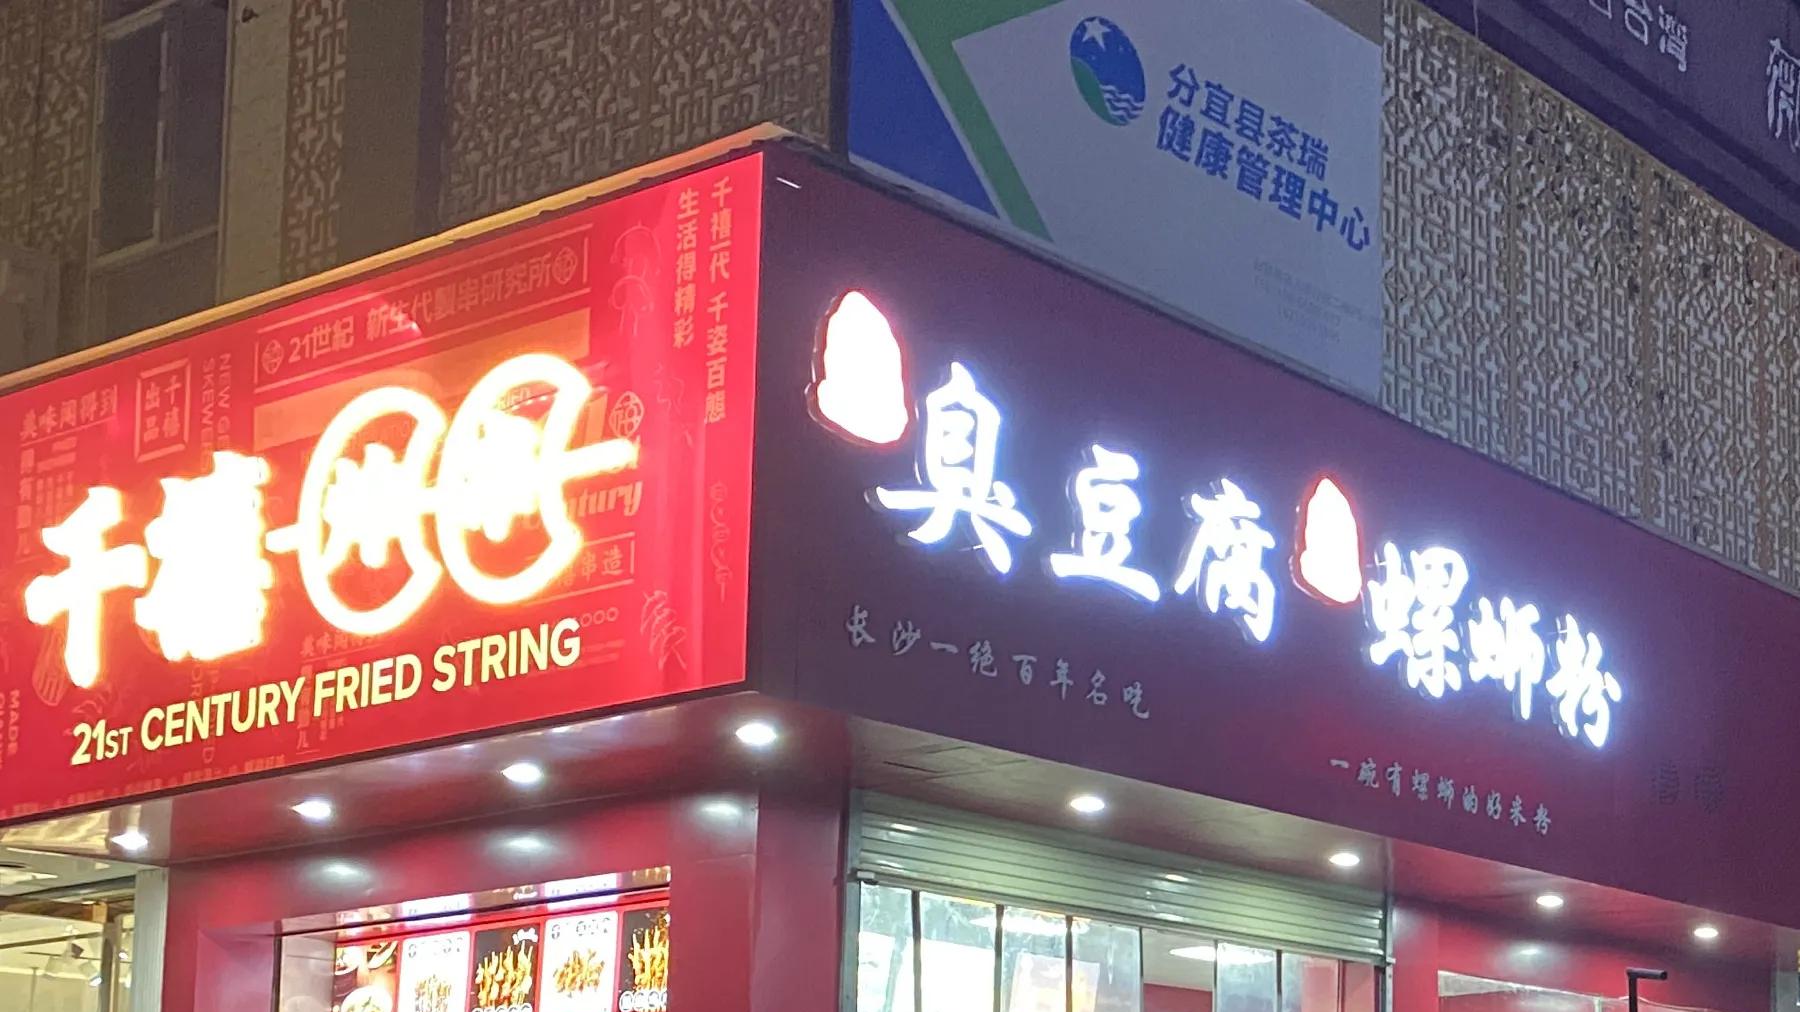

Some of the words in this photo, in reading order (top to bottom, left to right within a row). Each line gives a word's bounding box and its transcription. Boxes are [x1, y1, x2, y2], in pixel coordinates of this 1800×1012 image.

[1157, 105, 1371, 252] 健康管理中心
[1166, 63, 1330, 180] 分宜县茶瑞
[672, 187, 700, 348] 生活得精彩
[875, 361, 1284, 643] 臭豆腐
[141, 676, 305, 751] CENTURY
[313, 655, 422, 718] FRIED
[432, 617, 581, 692] STRING
[847, 604, 1150, 720] 长沙一绝百年名吃
[1365, 540, 1622, 748] 螺蛳粉
[1329, 757, 1552, 835] 一碗有螺蛳的好米粉
